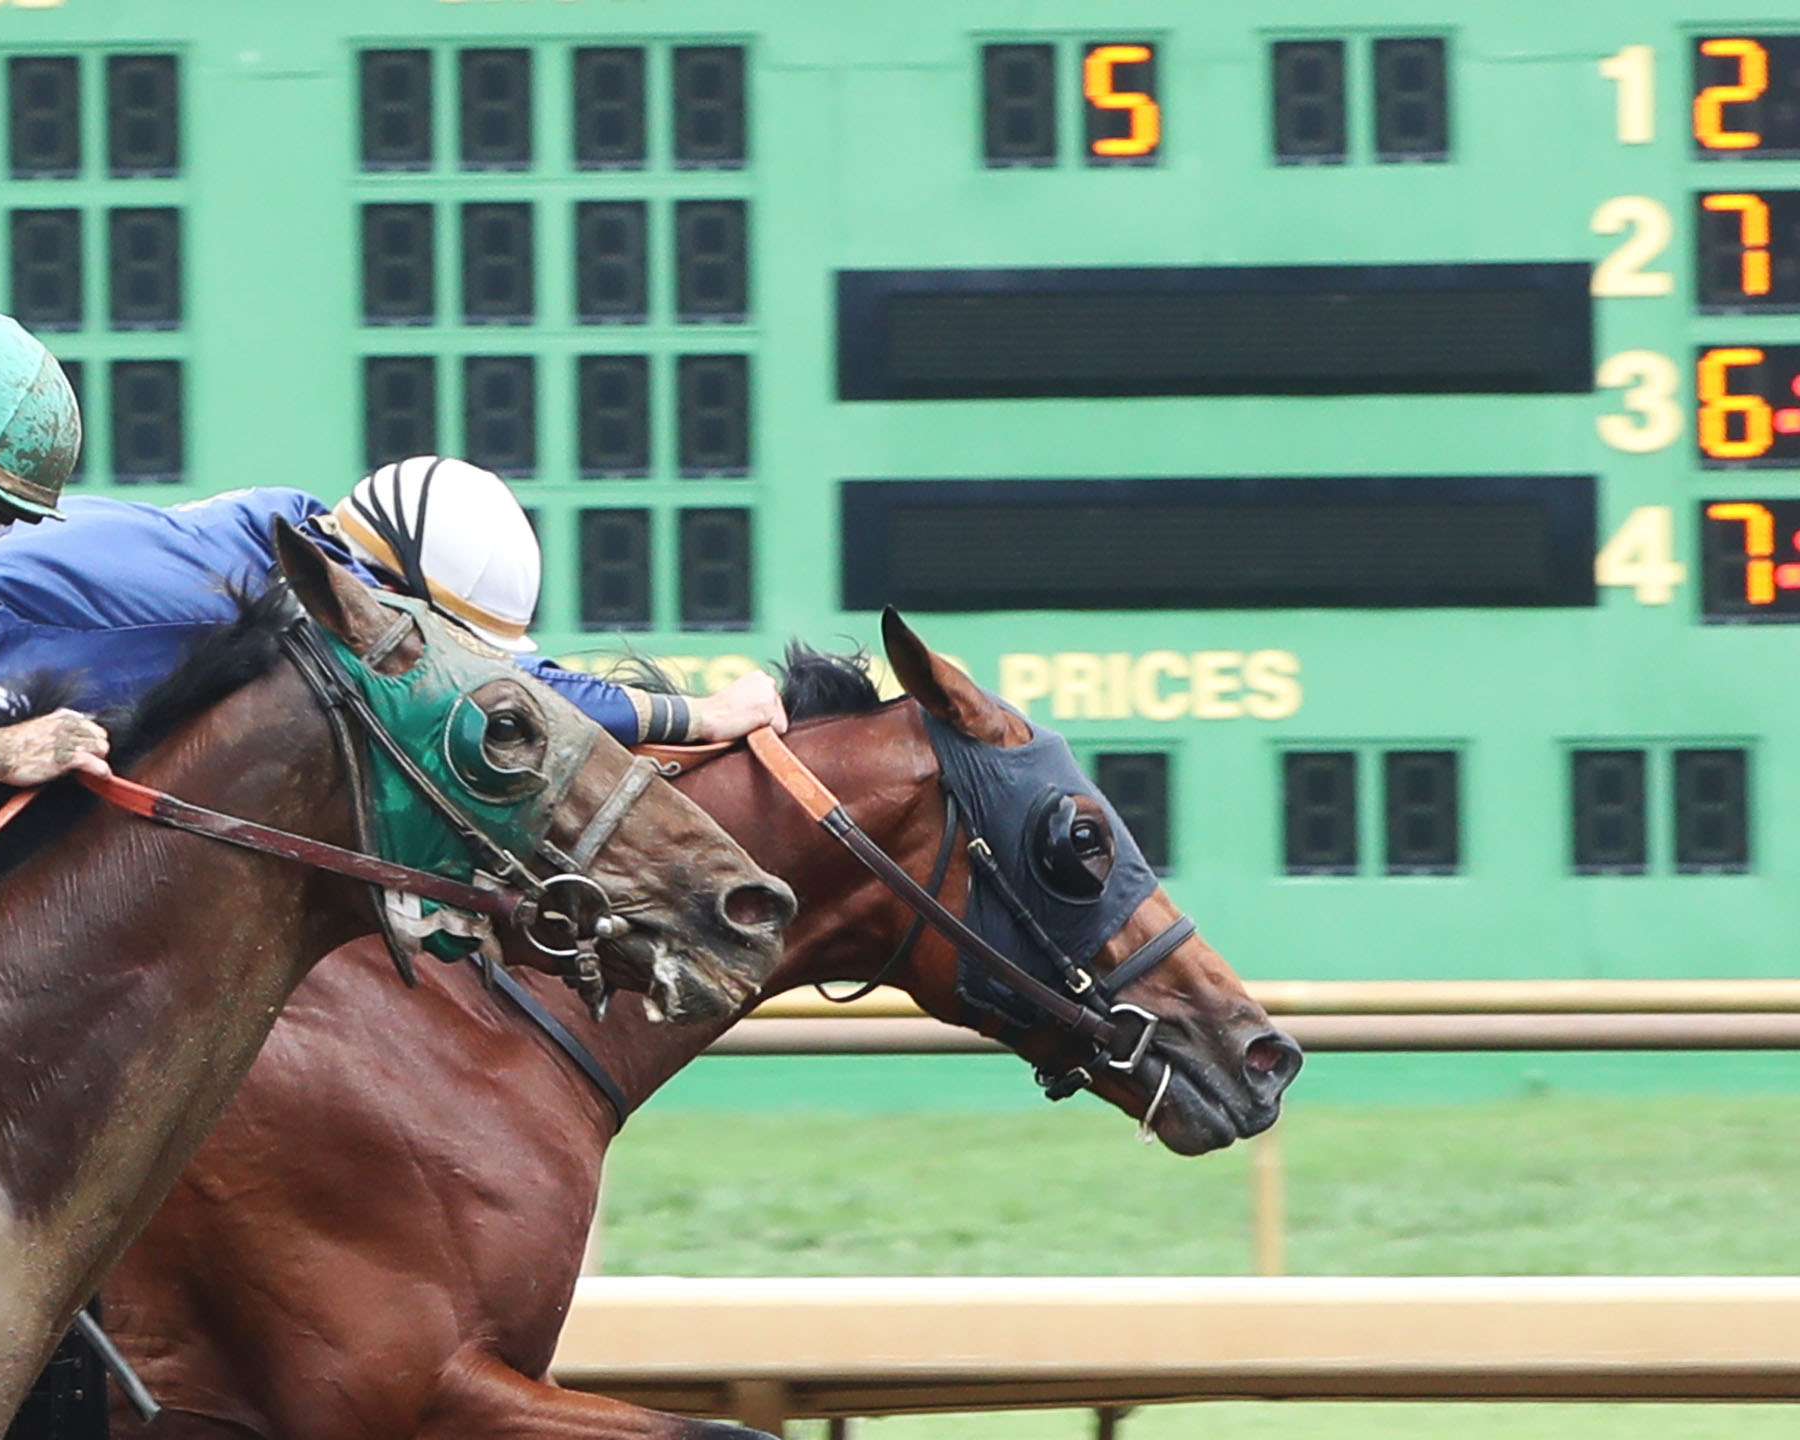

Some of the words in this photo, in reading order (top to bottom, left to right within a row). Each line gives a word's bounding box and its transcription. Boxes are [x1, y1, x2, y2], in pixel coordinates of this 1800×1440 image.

[1083, 45, 1160, 155] 5
[1600, 45, 1655, 143] 1
[1693, 38, 1767, 149] 2
[1590, 195, 1673, 297] 2
[1702, 194, 1769, 295] 7
[1596, 350, 1683, 453] 3
[1595, 505, 1686, 604] 4
[1001, 650, 1303, 720] PRICES
